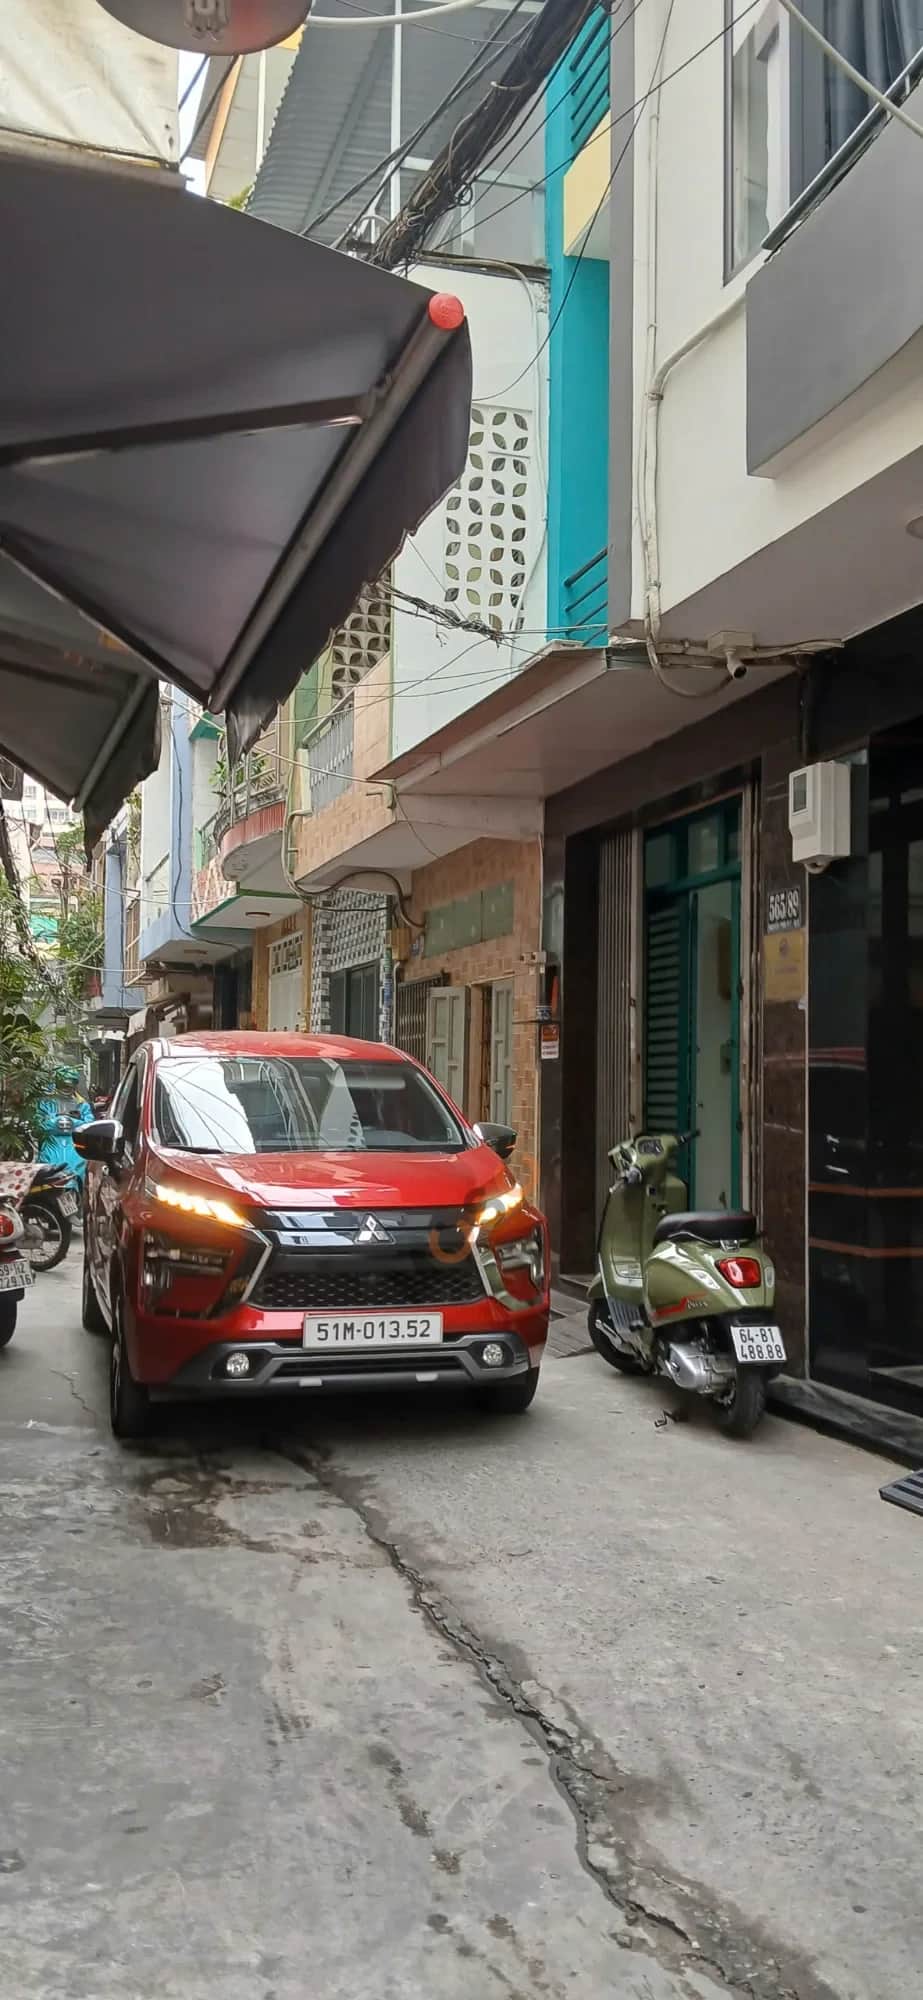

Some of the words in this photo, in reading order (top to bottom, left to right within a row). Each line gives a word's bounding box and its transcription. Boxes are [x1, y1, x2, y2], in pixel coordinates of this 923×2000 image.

[317, 1319, 431, 1341] 51M-013.52
[739, 1328, 774, 1343] 64-B1
[740, 1344, 783, 1360] 488.88
